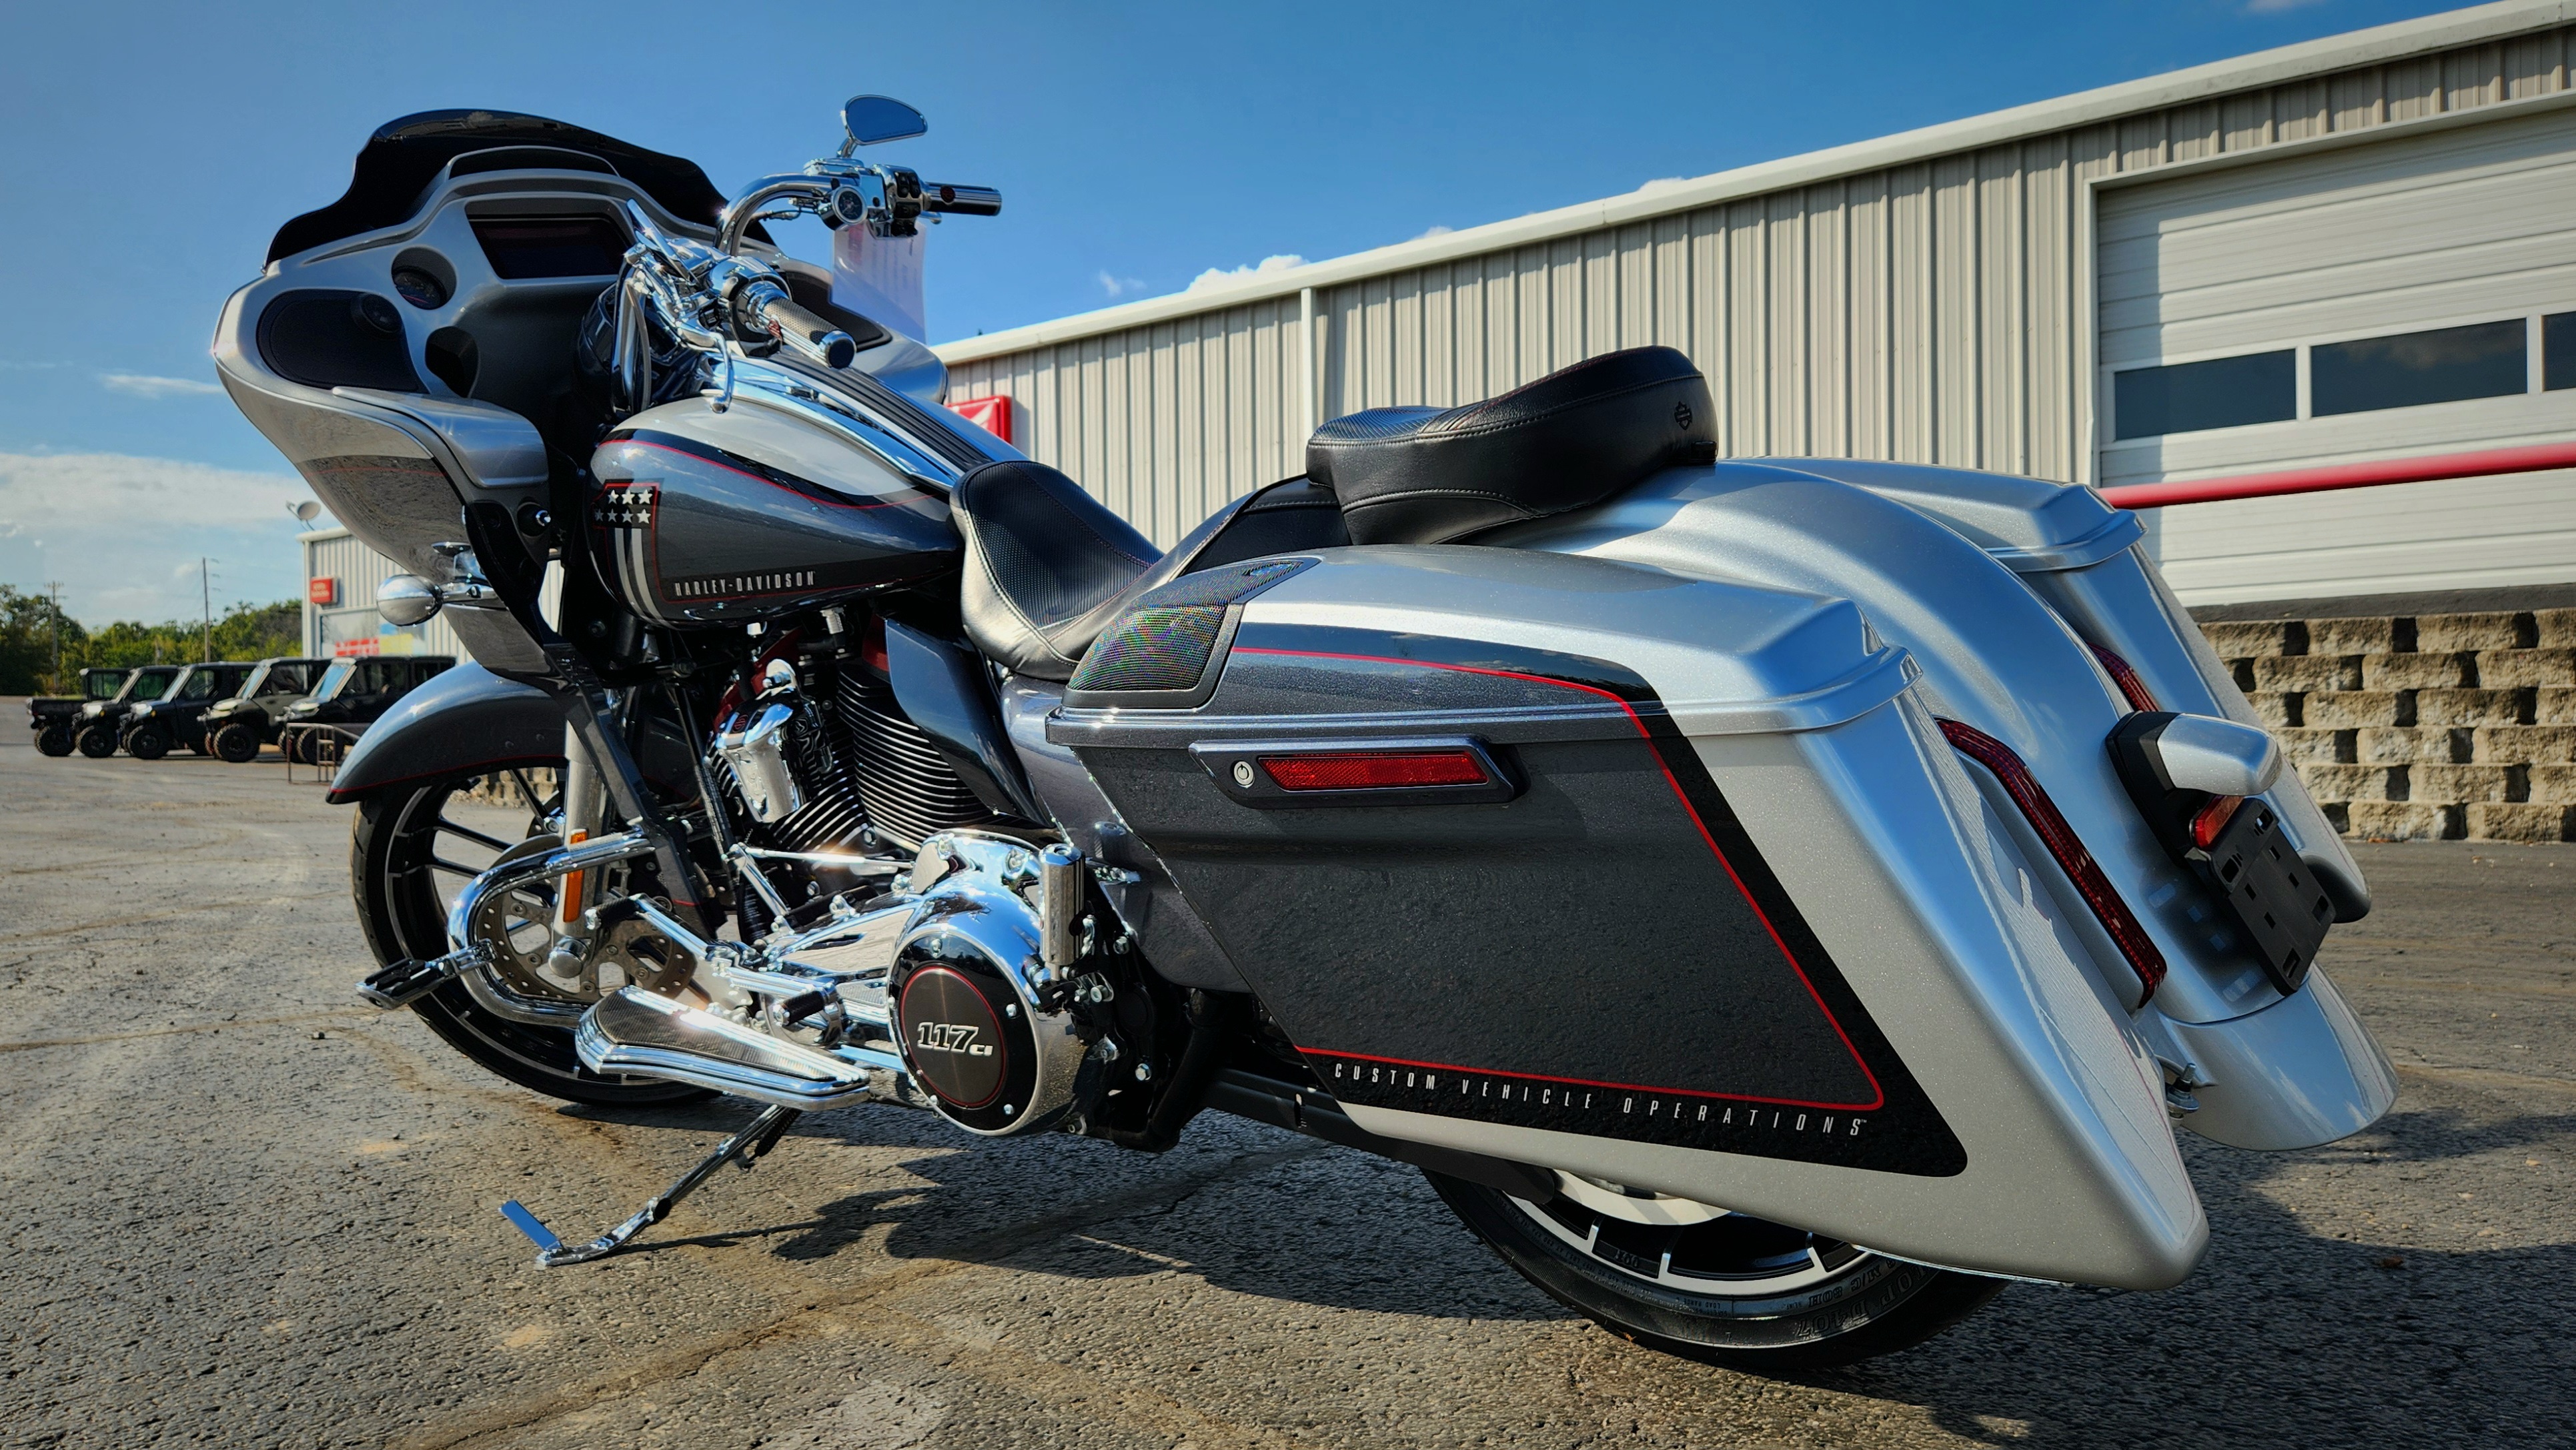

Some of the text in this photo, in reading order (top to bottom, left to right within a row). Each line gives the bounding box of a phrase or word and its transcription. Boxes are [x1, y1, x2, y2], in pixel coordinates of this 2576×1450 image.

[674, 571, 814, 596] HARLEY-DAVIDSON
[917, 1022, 979, 1052] 117
[1335, 1063, 1435, 1090] CUSTOM
[1462, 1079, 1591, 1109] VEHICLE
